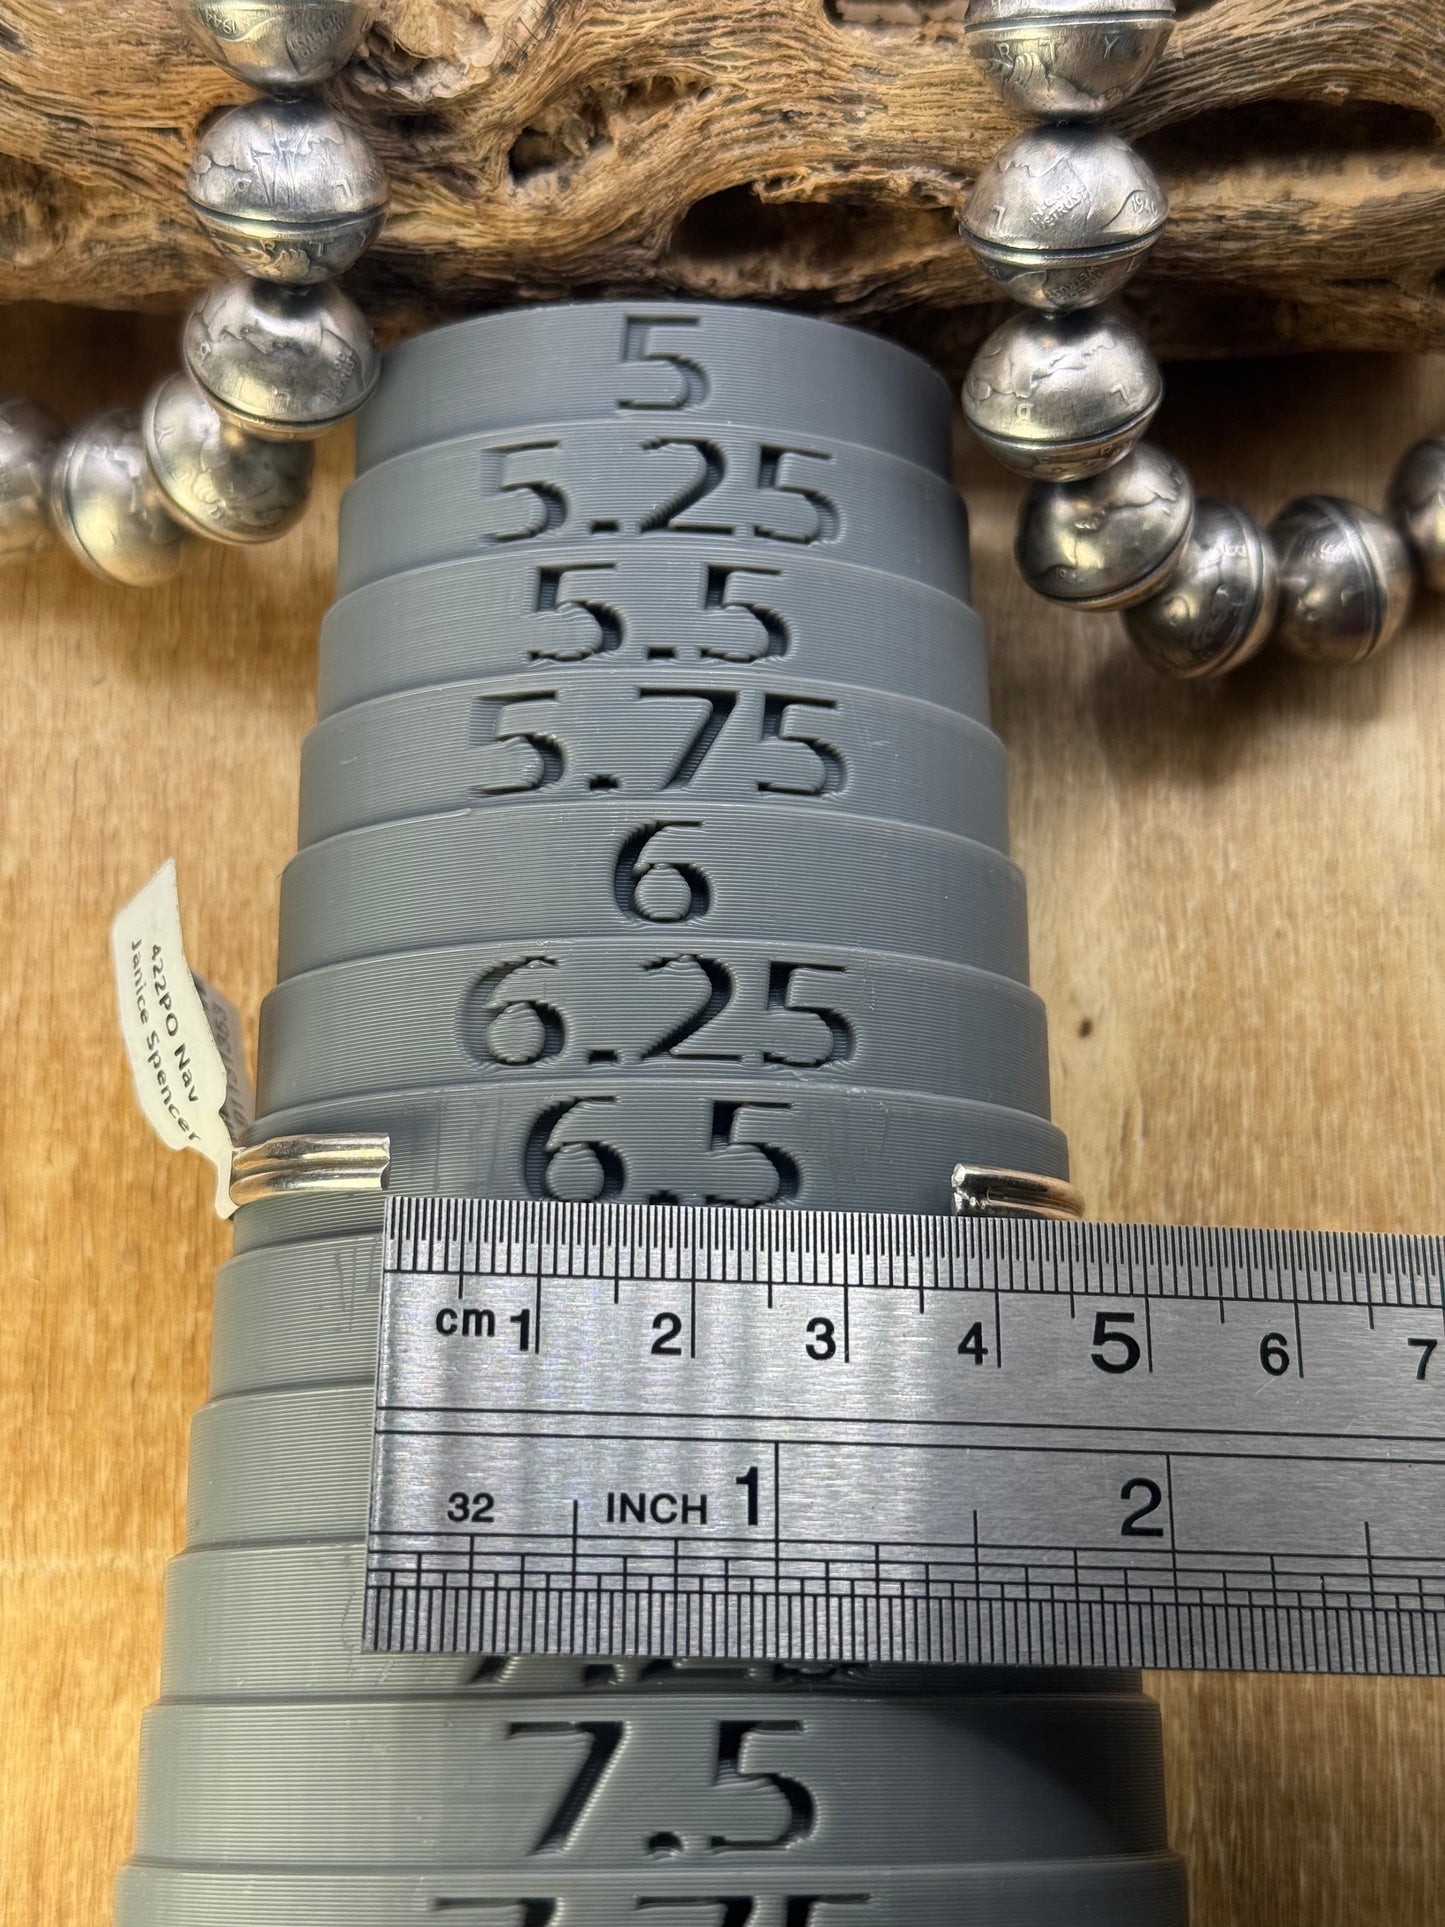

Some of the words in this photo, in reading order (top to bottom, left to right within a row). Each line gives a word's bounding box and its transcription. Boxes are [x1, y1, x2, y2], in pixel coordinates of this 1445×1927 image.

[616, 314, 710, 411] 5
[478, 437, 846, 546] 5.25
[526, 563, 795, 664] 5.5
[467, 686, 853, 796] 5.75
[614, 821, 714, 924] 6
[131, 938, 150, 1026] Janice
[145, 1032, 202, 1143] Spencer
[455, 954, 857, 1069] 6.25
[173, 1042, 200, 1104] Nav
[523, 1096, 802, 1206] 6.5
[435, 1307, 496, 1337] cm
[510, 1309, 530, 1351] 1
[651, 1312, 682, 1356] 2
[805, 1317, 836, 1361] 3
[957, 1322, 989, 1366] 4
[1090, 1312, 1141, 1374] 5
[1259, 1332, 1290, 1376] 6
[1407, 1338, 1438, 1380] 7
[447, 1492, 496, 1524] 32
[606, 1493, 708, 1526] INCH
[735, 1467, 759, 1526] 1
[1120, 1477, 1164, 1537] 2
[507, 1720, 821, 1856] 7.5
